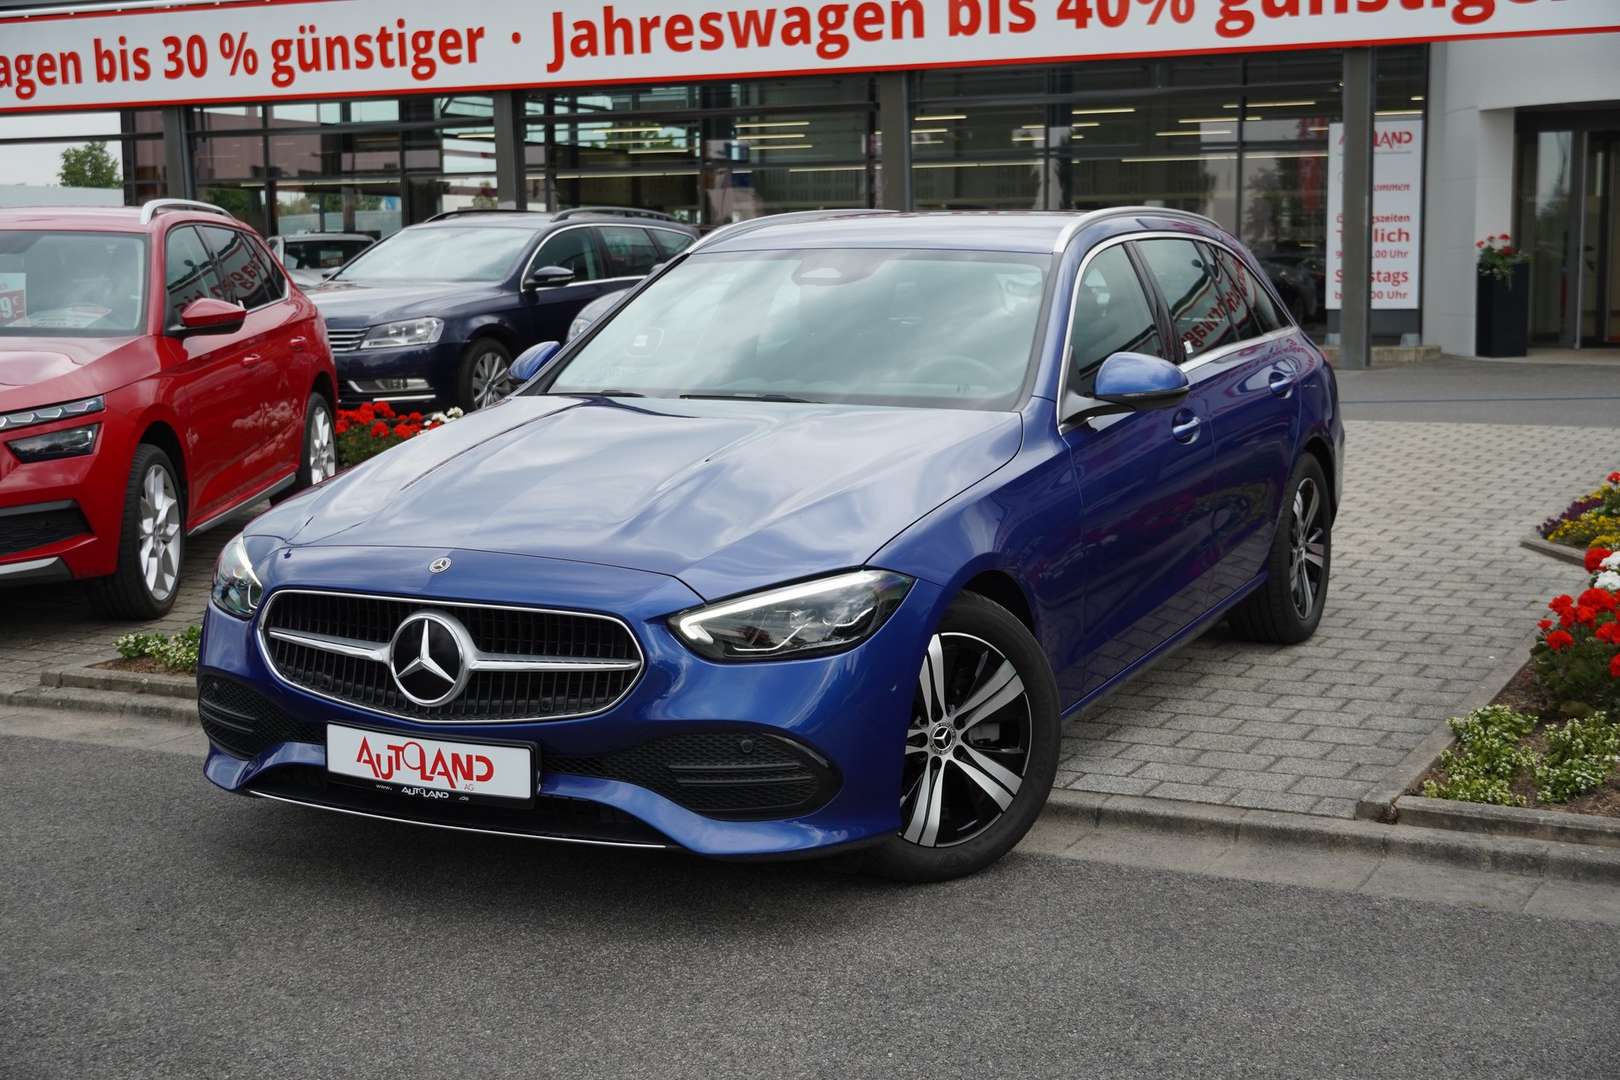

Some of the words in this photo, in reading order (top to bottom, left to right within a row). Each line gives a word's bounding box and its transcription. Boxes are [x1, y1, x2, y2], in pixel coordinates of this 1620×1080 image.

[94, 36, 150, 82] bis
[163, 34, 208, 79] 30
[219, 32, 259, 75] %
[271, 18, 485, 88] günstiger
[546, 0, 924, 74] Jahreswagen
[1389, 249, 1409, 258] Uhr
[1387, 290, 1408, 299] Uhr
[357, 736, 494, 789] AUTOLAND
[401, 786, 450, 799] AUTOLAND
